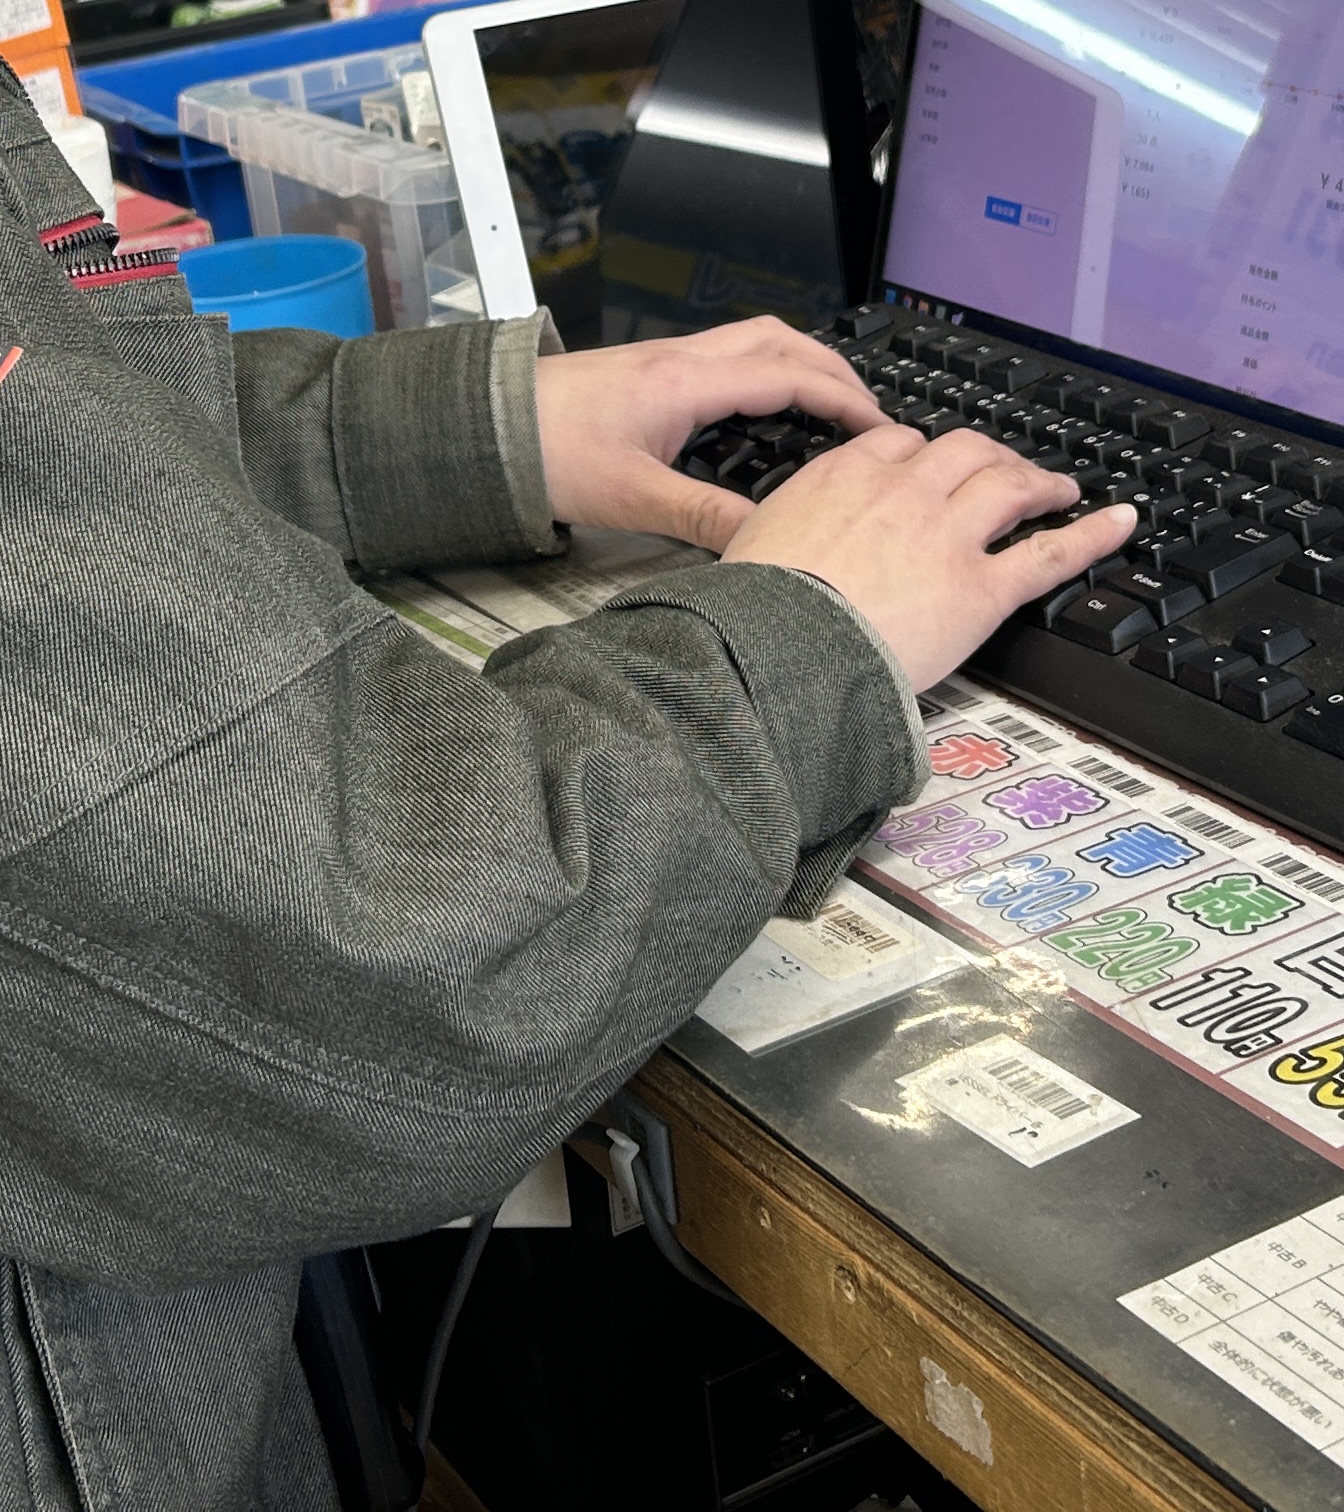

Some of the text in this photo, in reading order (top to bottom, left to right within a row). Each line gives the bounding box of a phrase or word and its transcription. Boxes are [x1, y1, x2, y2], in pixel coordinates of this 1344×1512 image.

[928, 732, 1020, 780] 赤
[982, 773, 1110, 830] 紫
[872, 802, 1009, 879] 528円
[1075, 822, 1205, 879] 青
[1167, 872, 1306, 937] 緑
[1040, 907, 1201, 995] 220円
[1149, 966, 1309, 1059] 110円
[1150, 1294, 1191, 1325] 中古D
[1196, 1271, 1240, 1303] 中古C
[1207, 1337, 1334, 1431] 全体的に状態が悪い
